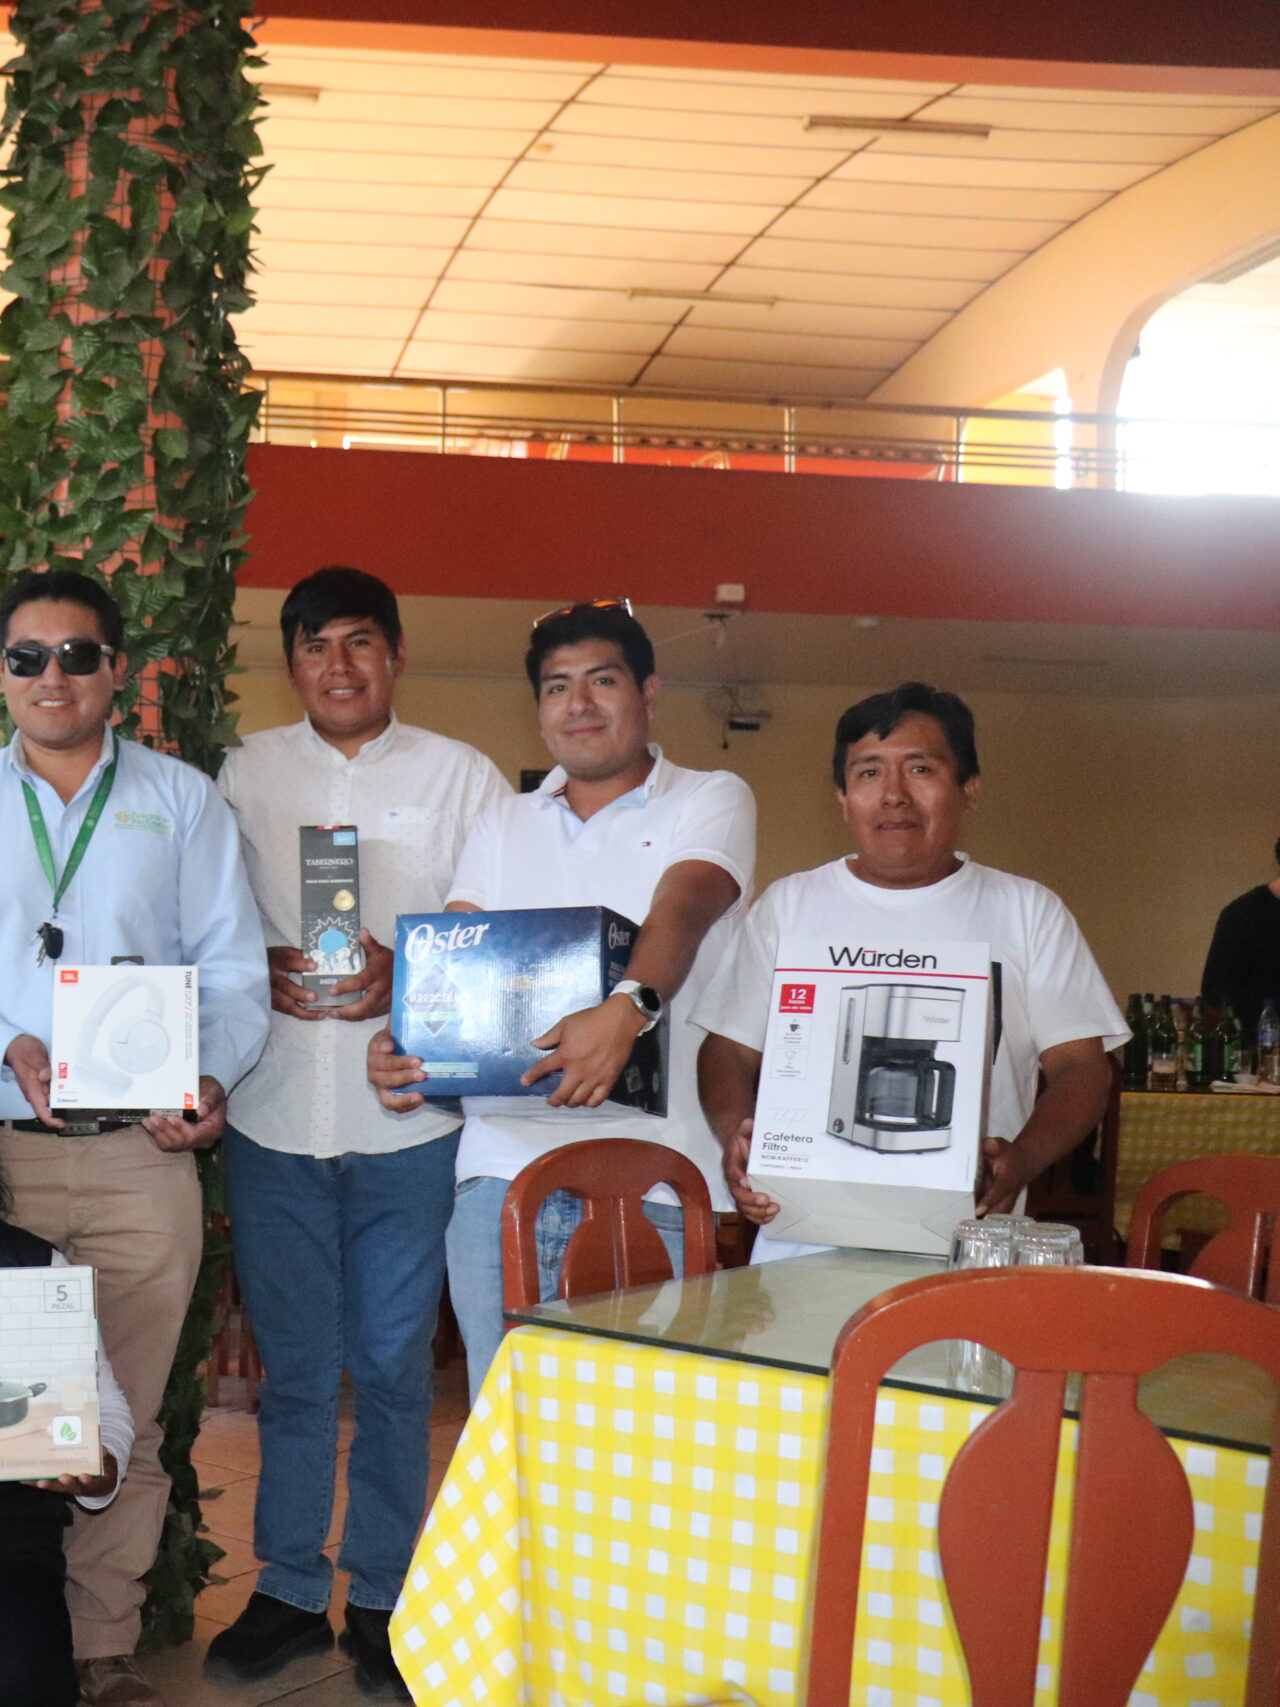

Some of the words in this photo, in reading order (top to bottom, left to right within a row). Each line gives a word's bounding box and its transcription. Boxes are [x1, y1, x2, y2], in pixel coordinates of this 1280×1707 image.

[404, 922, 491, 964] Oster
[607, 922, 630, 949] Oster
[790, 988, 807, 1000] 12
[763, 1131, 813, 1143] Cafetera
[762, 1142, 788, 1152] Filtro
[56, 1284, 68, 1302] 5
